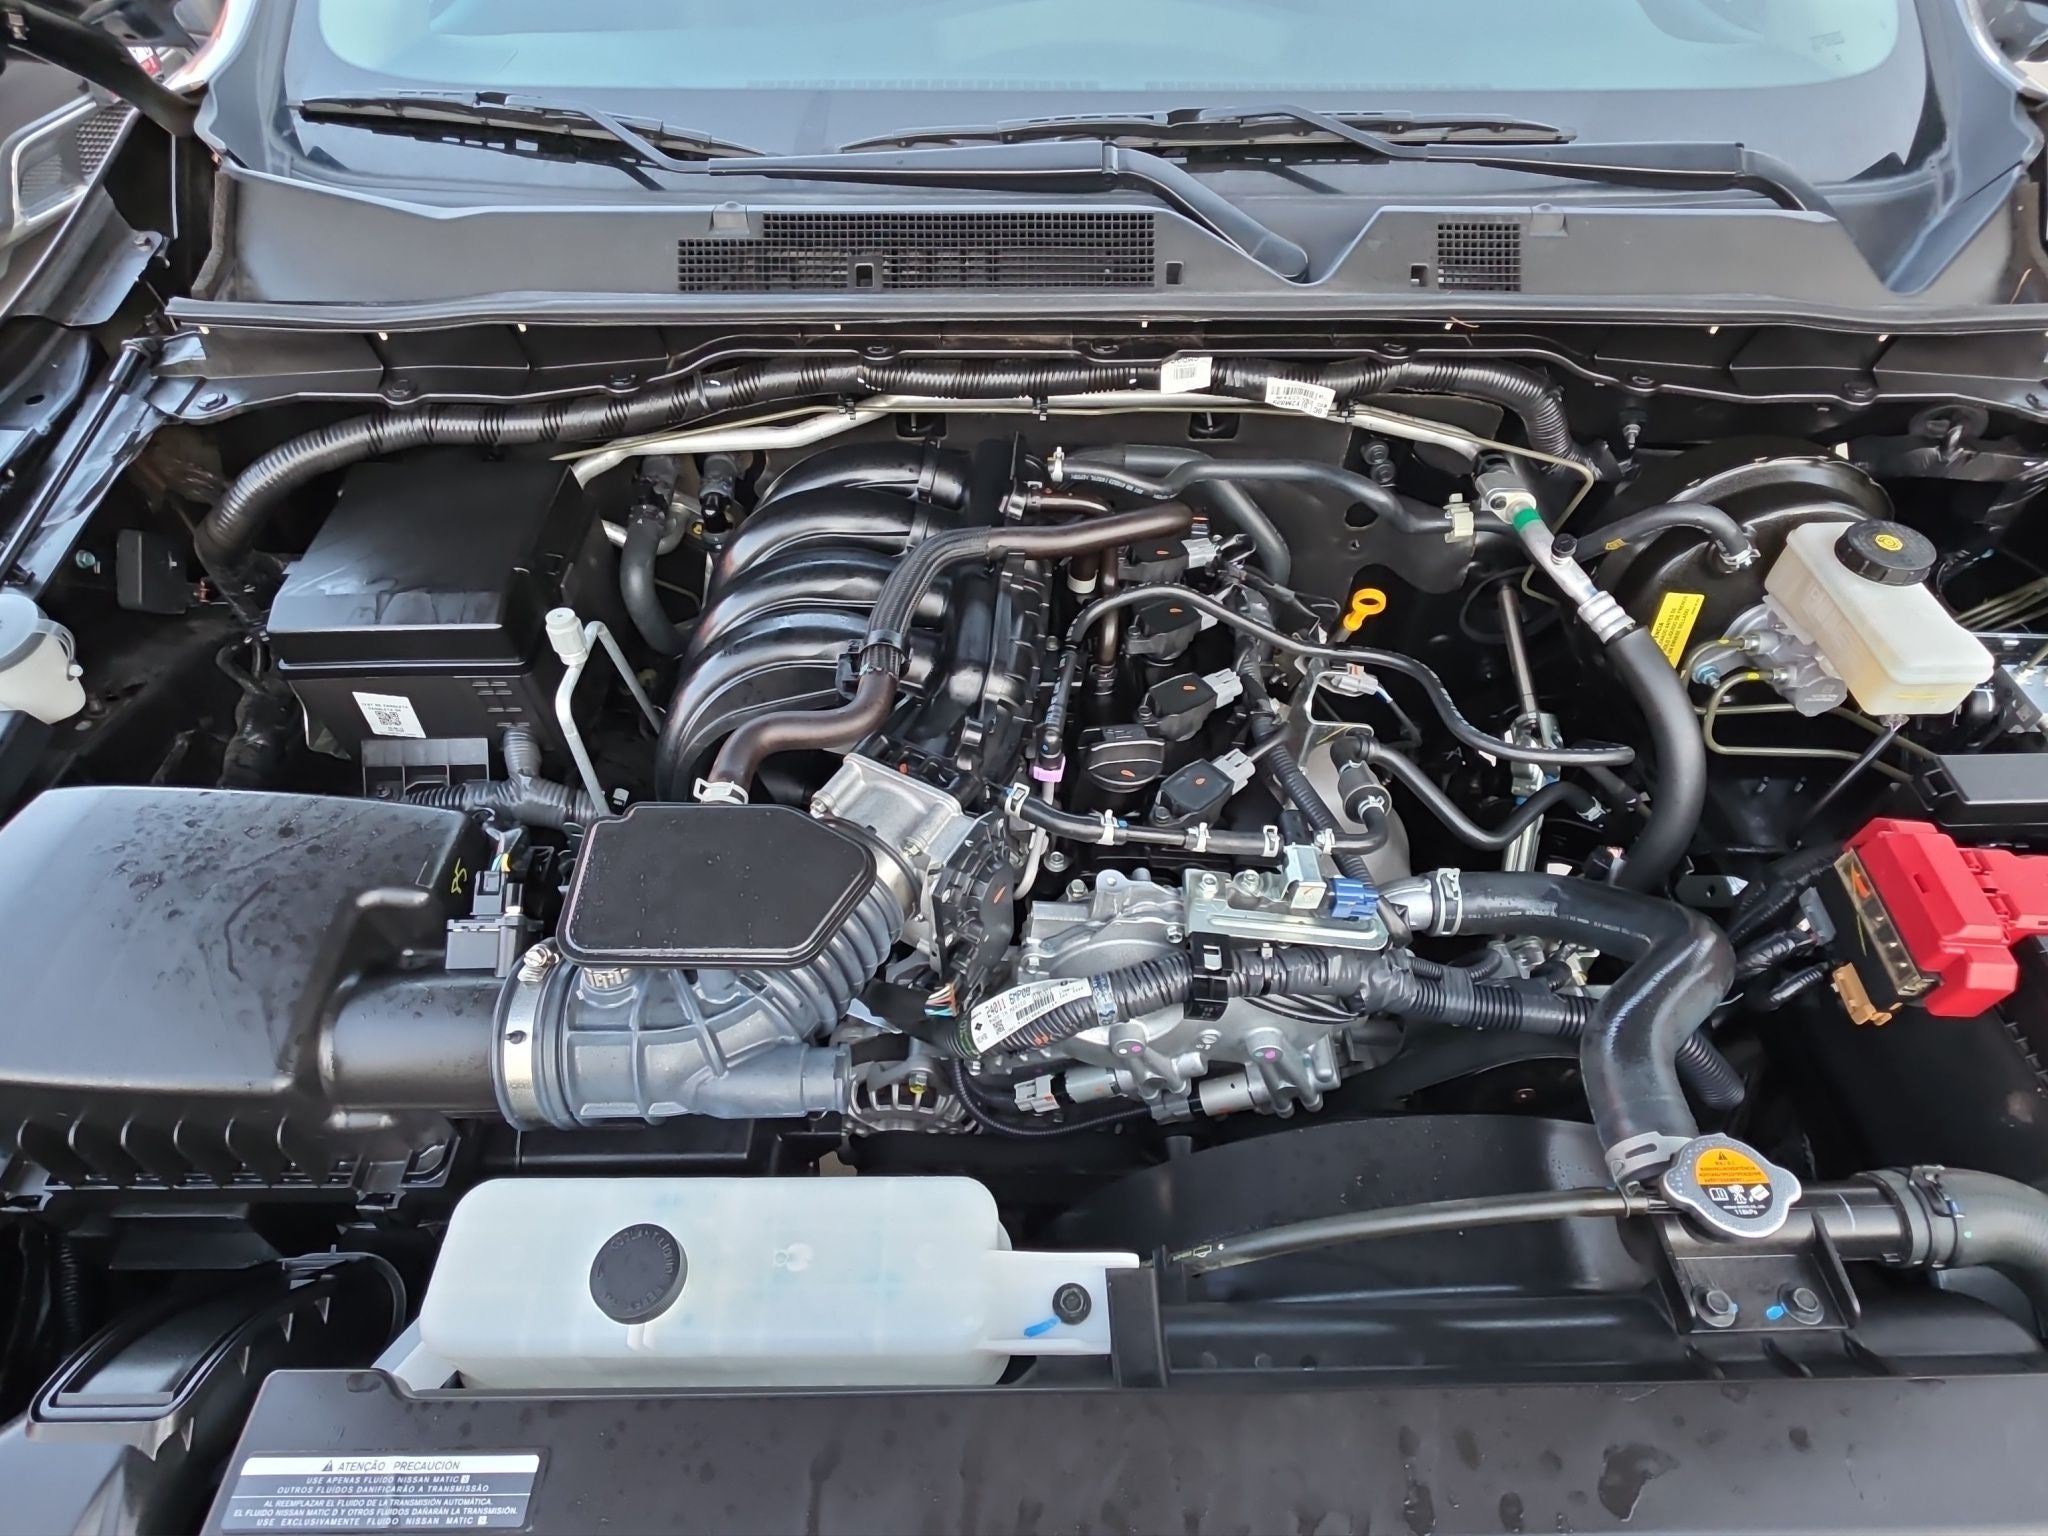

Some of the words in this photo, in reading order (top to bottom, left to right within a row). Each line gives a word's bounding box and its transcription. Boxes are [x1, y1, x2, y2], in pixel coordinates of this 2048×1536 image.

[337, 1459, 385, 1472] ATENÇÃO
[306, 1476, 323, 1484] USE
[326, 1476, 360, 1484] APENAS
[397, 1475, 430, 1483] NISSAN
[433, 1475, 459, 1483] MATIC
[277, 1486, 313, 1494] OUTROS
[356, 1485, 415, 1494] DANIFICARÃO
[427, 1484, 489, 1493] TRANSMISSÃO
[275, 1509, 304, 1517] NISSAN
[281, 1518, 360, 1526] EXCLUSIVAMENTE
[405, 1517, 440, 1525] NISSAN
[446, 1517, 473, 1525] MATIC
